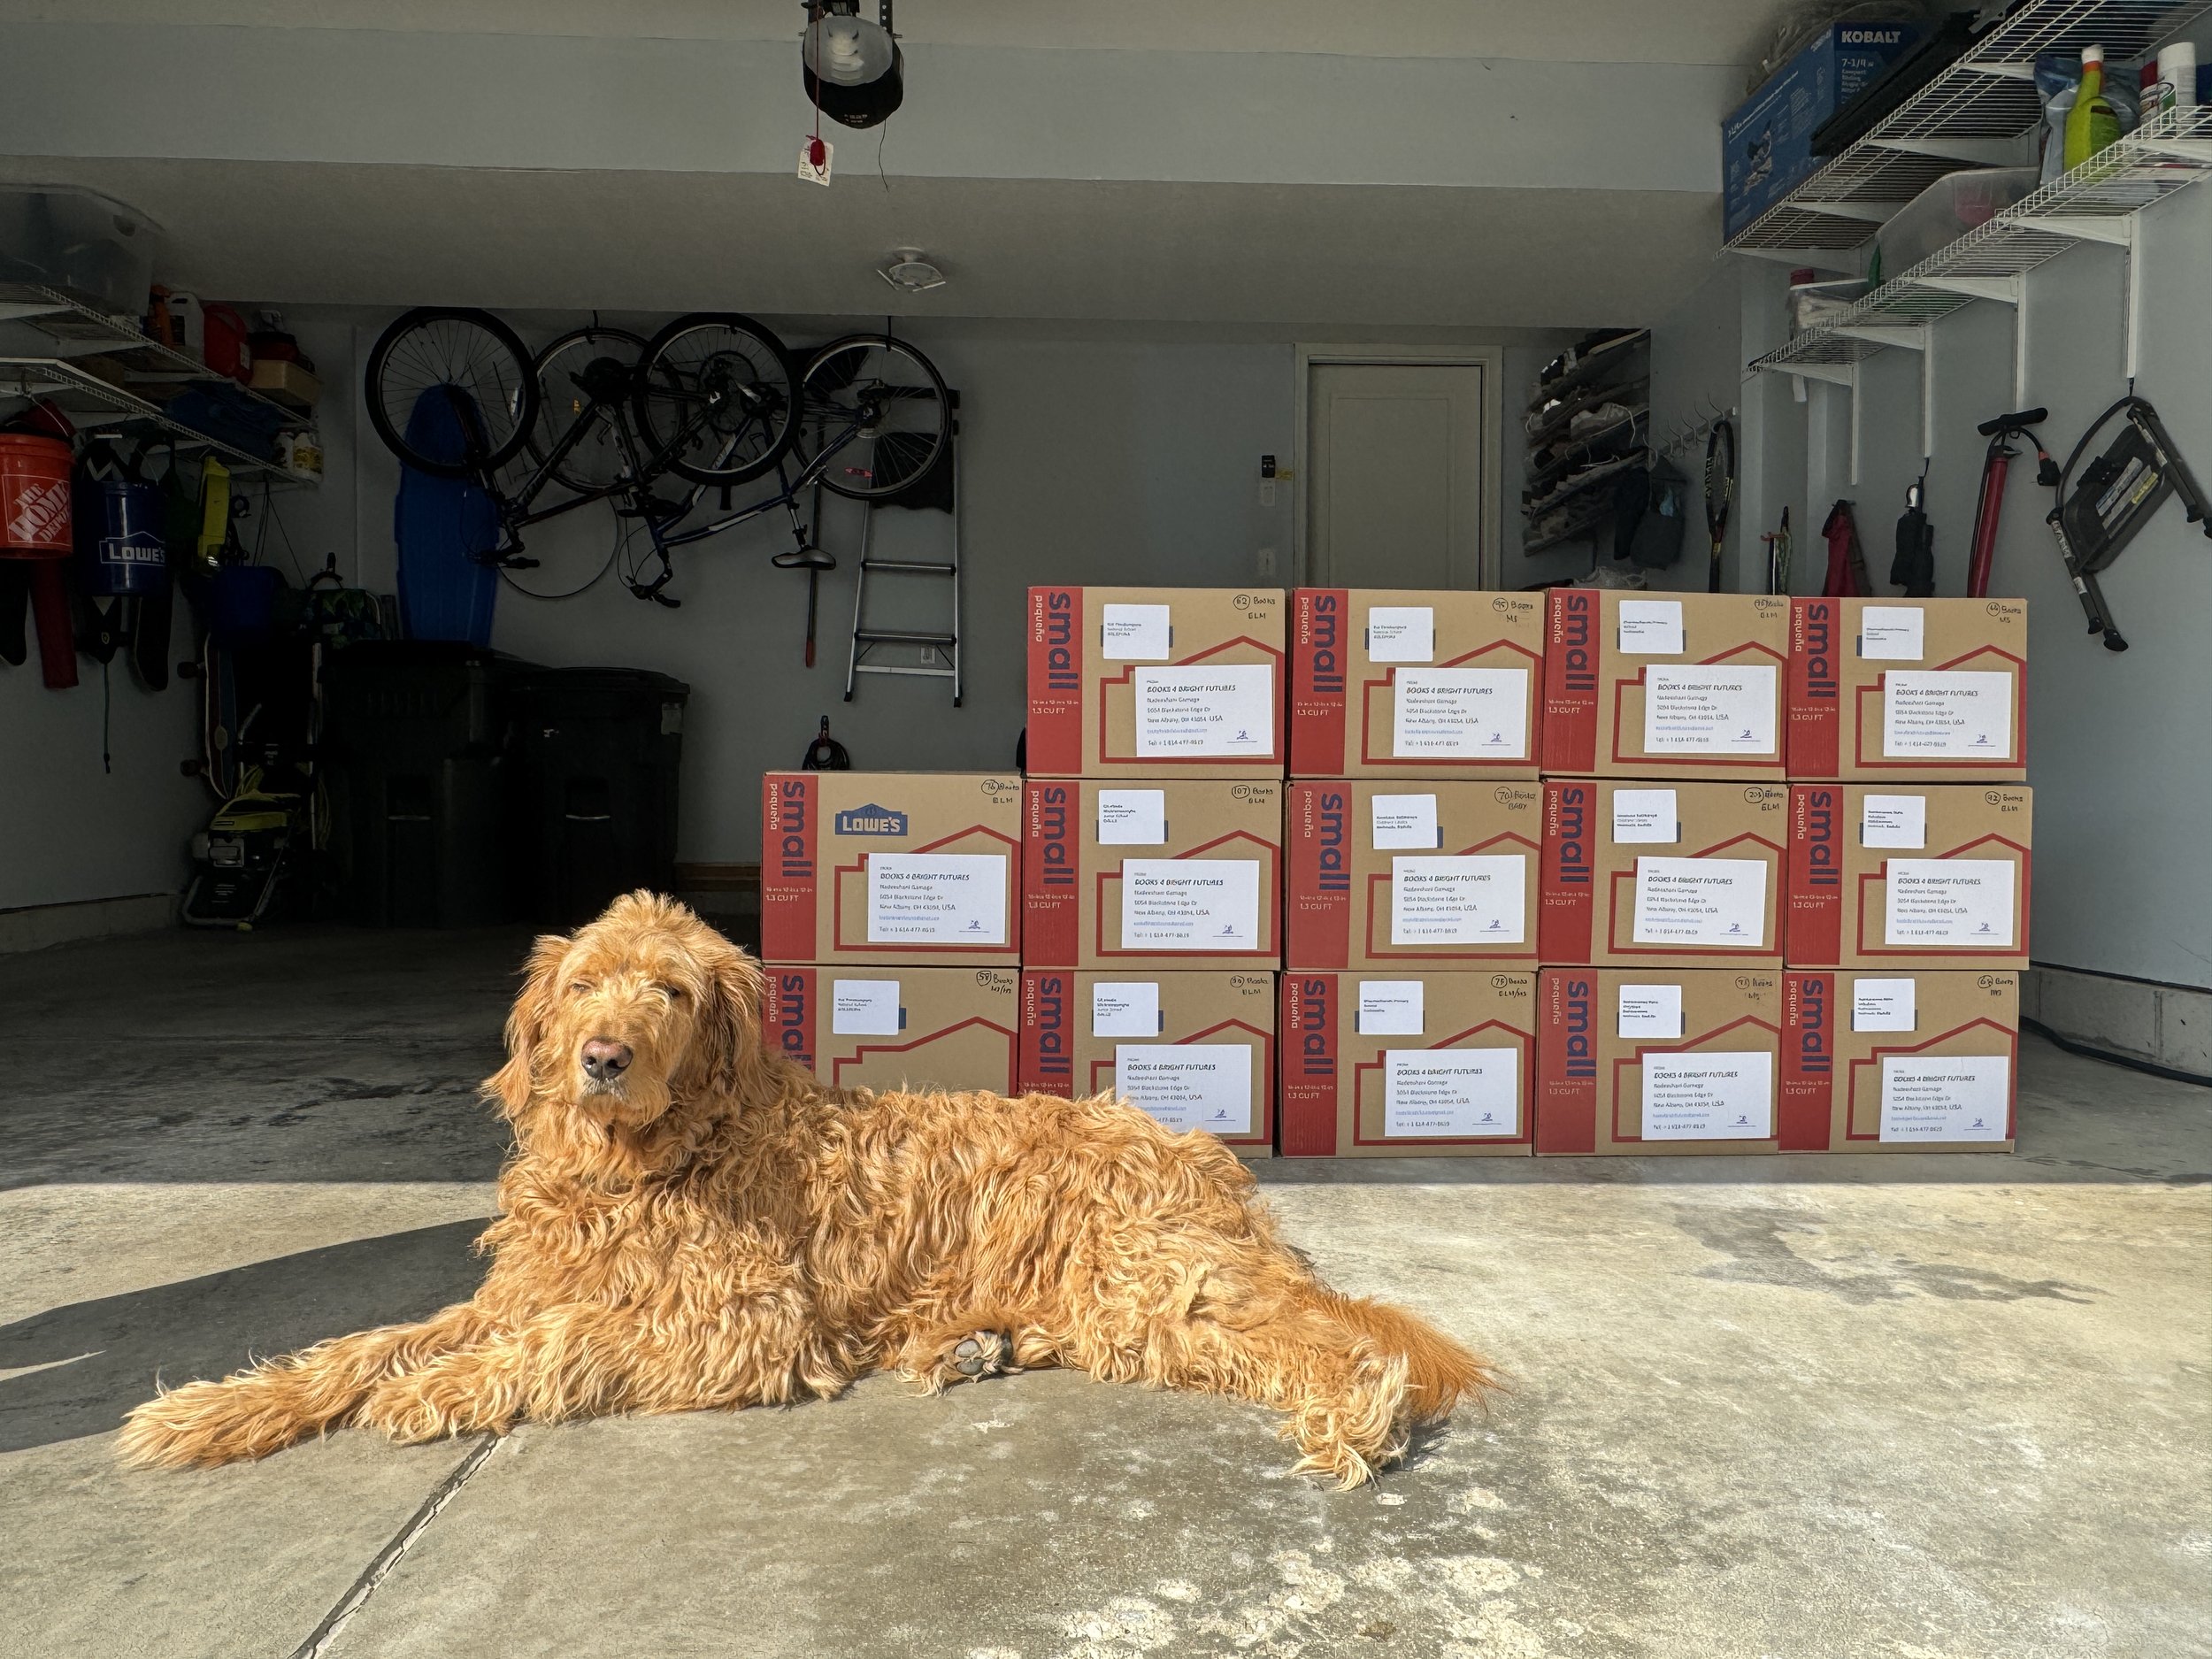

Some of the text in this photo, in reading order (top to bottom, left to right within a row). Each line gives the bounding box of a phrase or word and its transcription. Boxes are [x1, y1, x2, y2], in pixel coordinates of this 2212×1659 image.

[1841, 31, 1901, 43] KOBALT
[8, 481, 69, 543] HOME
[13, 483, 45, 510] THE
[109, 542, 165, 564] LOWE'S
[1034, 595, 1044, 641] pequeña
[1048, 592, 1079, 690] small
[1301, 597, 1310, 643] pequeña
[1554, 598, 1563, 643] pequeña
[1794, 607, 1804, 651] pequeña
[1313, 595, 1343, 692] small
[1566, 595, 1595, 691] small
[1808, 603, 1837, 697] small
[770, 784, 780, 829] pequeña
[782, 780, 813, 878] small
[843, 816, 900, 832] LOWE'S
[1031, 791, 1041, 837] pequeña
[1303, 791, 1313, 837] pequeña
[1549, 791, 1559, 835] pequeña
[1796, 795, 1807, 839] pequeña
[1043, 787, 1074, 885] small
[1319, 793, 1350, 891] small
[1560, 788, 1589, 883] small
[1809, 792, 1839, 884] small
[769, 977, 779, 1022] pequeña
[1026, 980, 1036, 1025] pequeña
[1290, 983, 1300, 1028] pequeña
[1552, 979, 1561, 1024] pequeña
[1789, 981, 1798, 1025] pequeña
[781, 975, 812, 1071] smal
[1039, 977, 1071, 1073] small
[1303, 979, 1333, 1075] small
[1566, 980, 1597, 1078] small
[1801, 979, 1832, 1073] small
